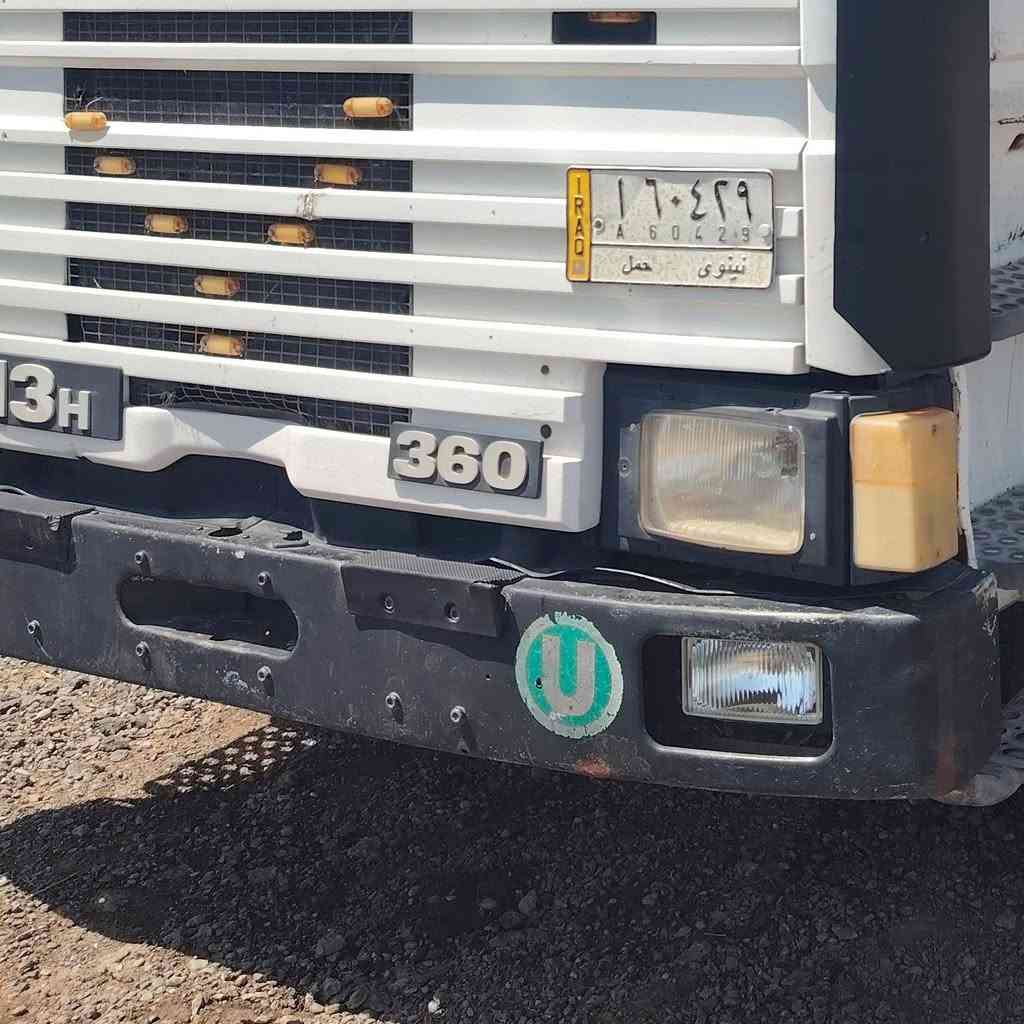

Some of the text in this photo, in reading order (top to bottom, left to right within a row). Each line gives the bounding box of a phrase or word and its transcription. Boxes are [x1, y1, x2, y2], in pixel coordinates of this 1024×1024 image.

[574, 176, 585, 257] IRAQ
[392, 430, 528, 491] 360
[540, 634, 597, 715] U
